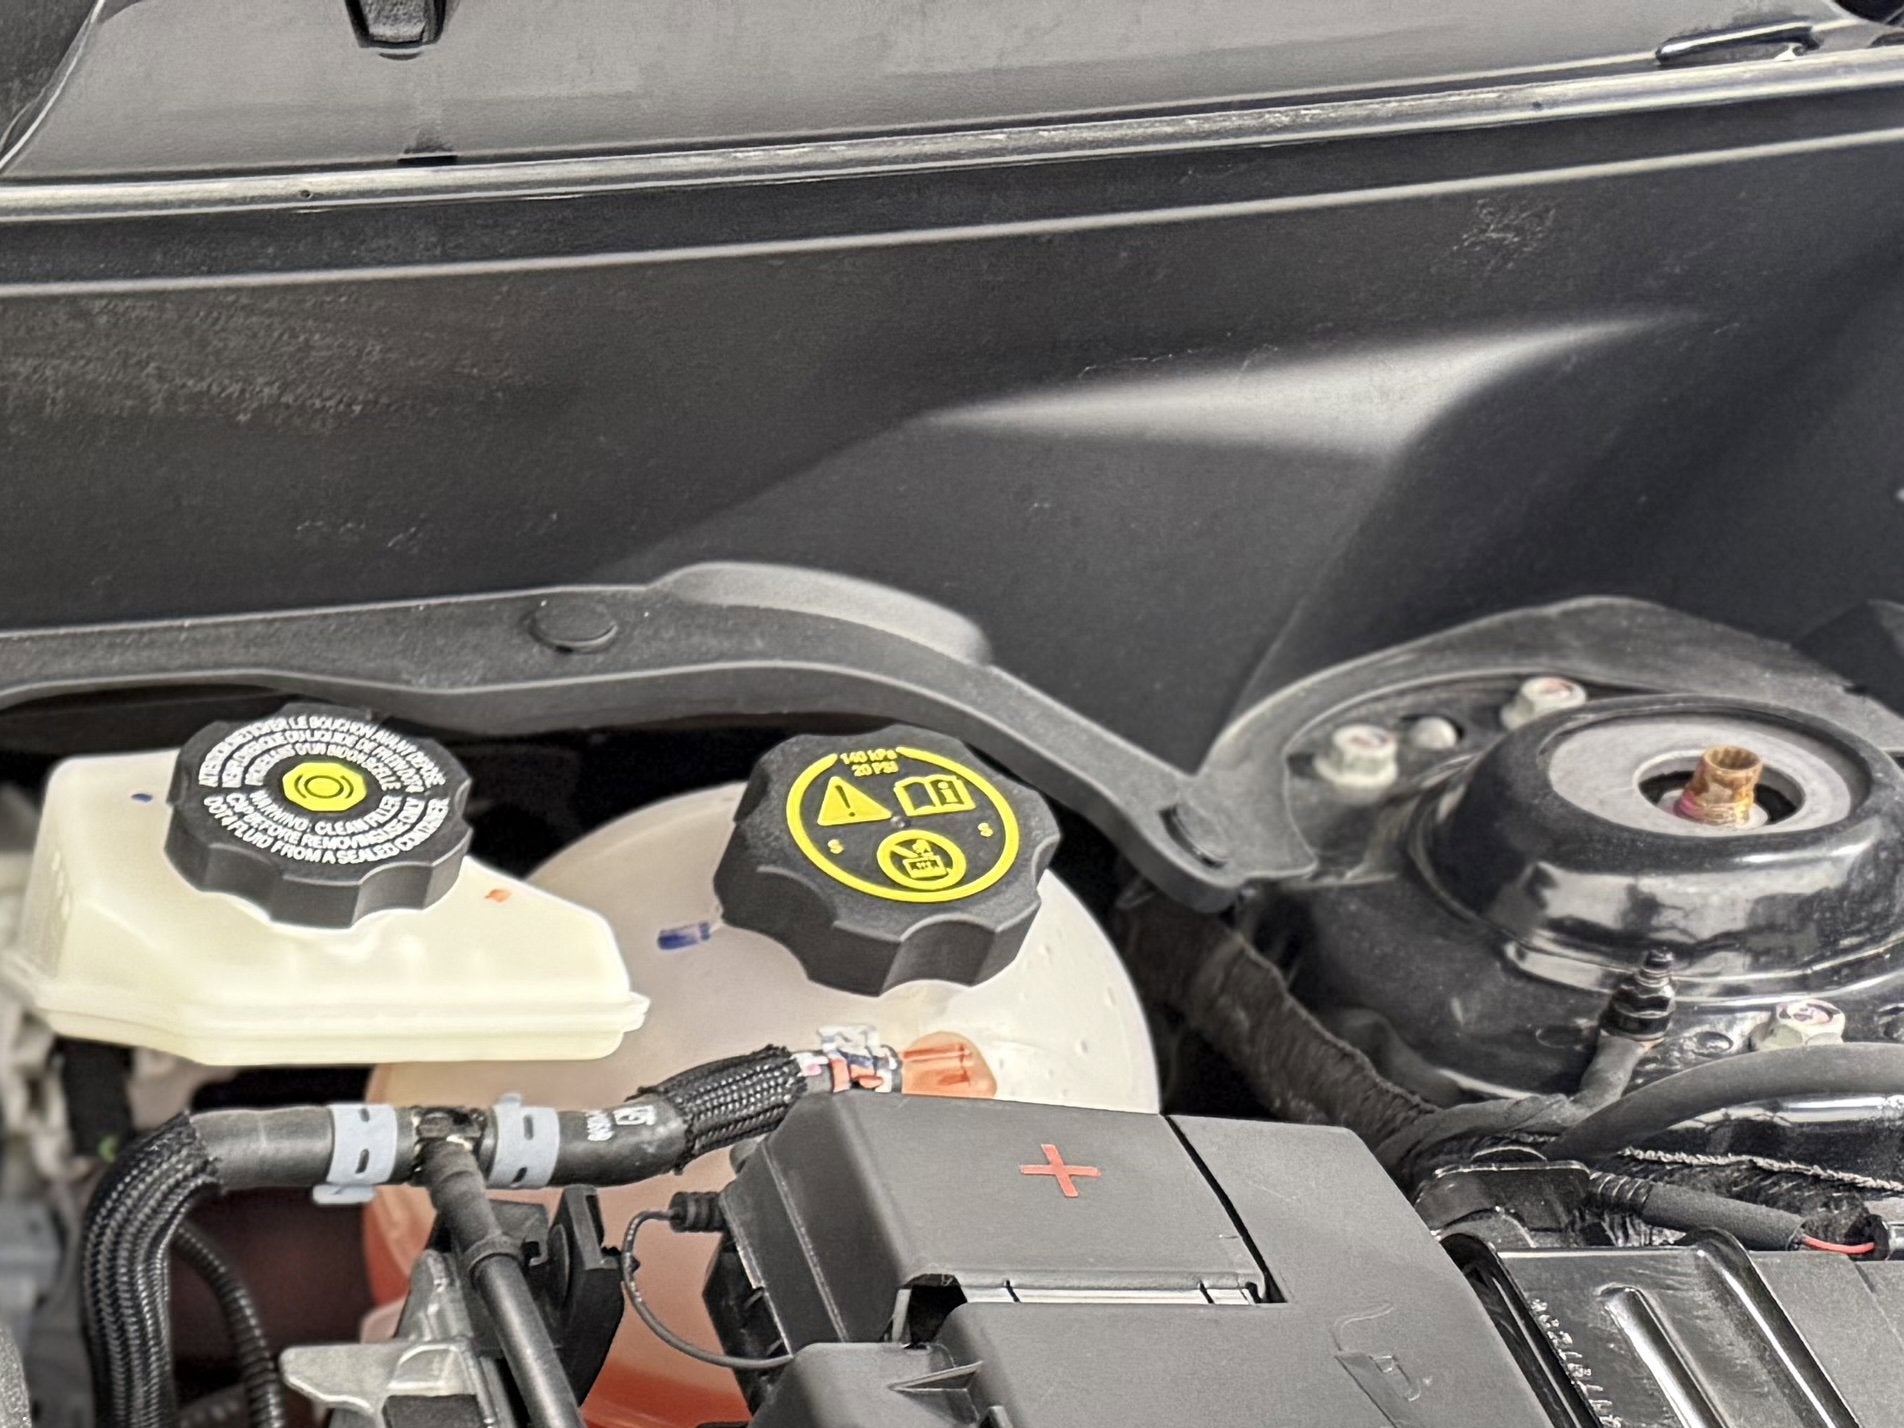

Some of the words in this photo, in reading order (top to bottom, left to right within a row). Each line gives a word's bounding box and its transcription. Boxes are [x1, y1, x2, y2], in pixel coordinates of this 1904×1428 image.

[851, 763, 873, 776] 20
[314, 817, 370, 836] CLEAN
[270, 840, 322, 863] FROM
